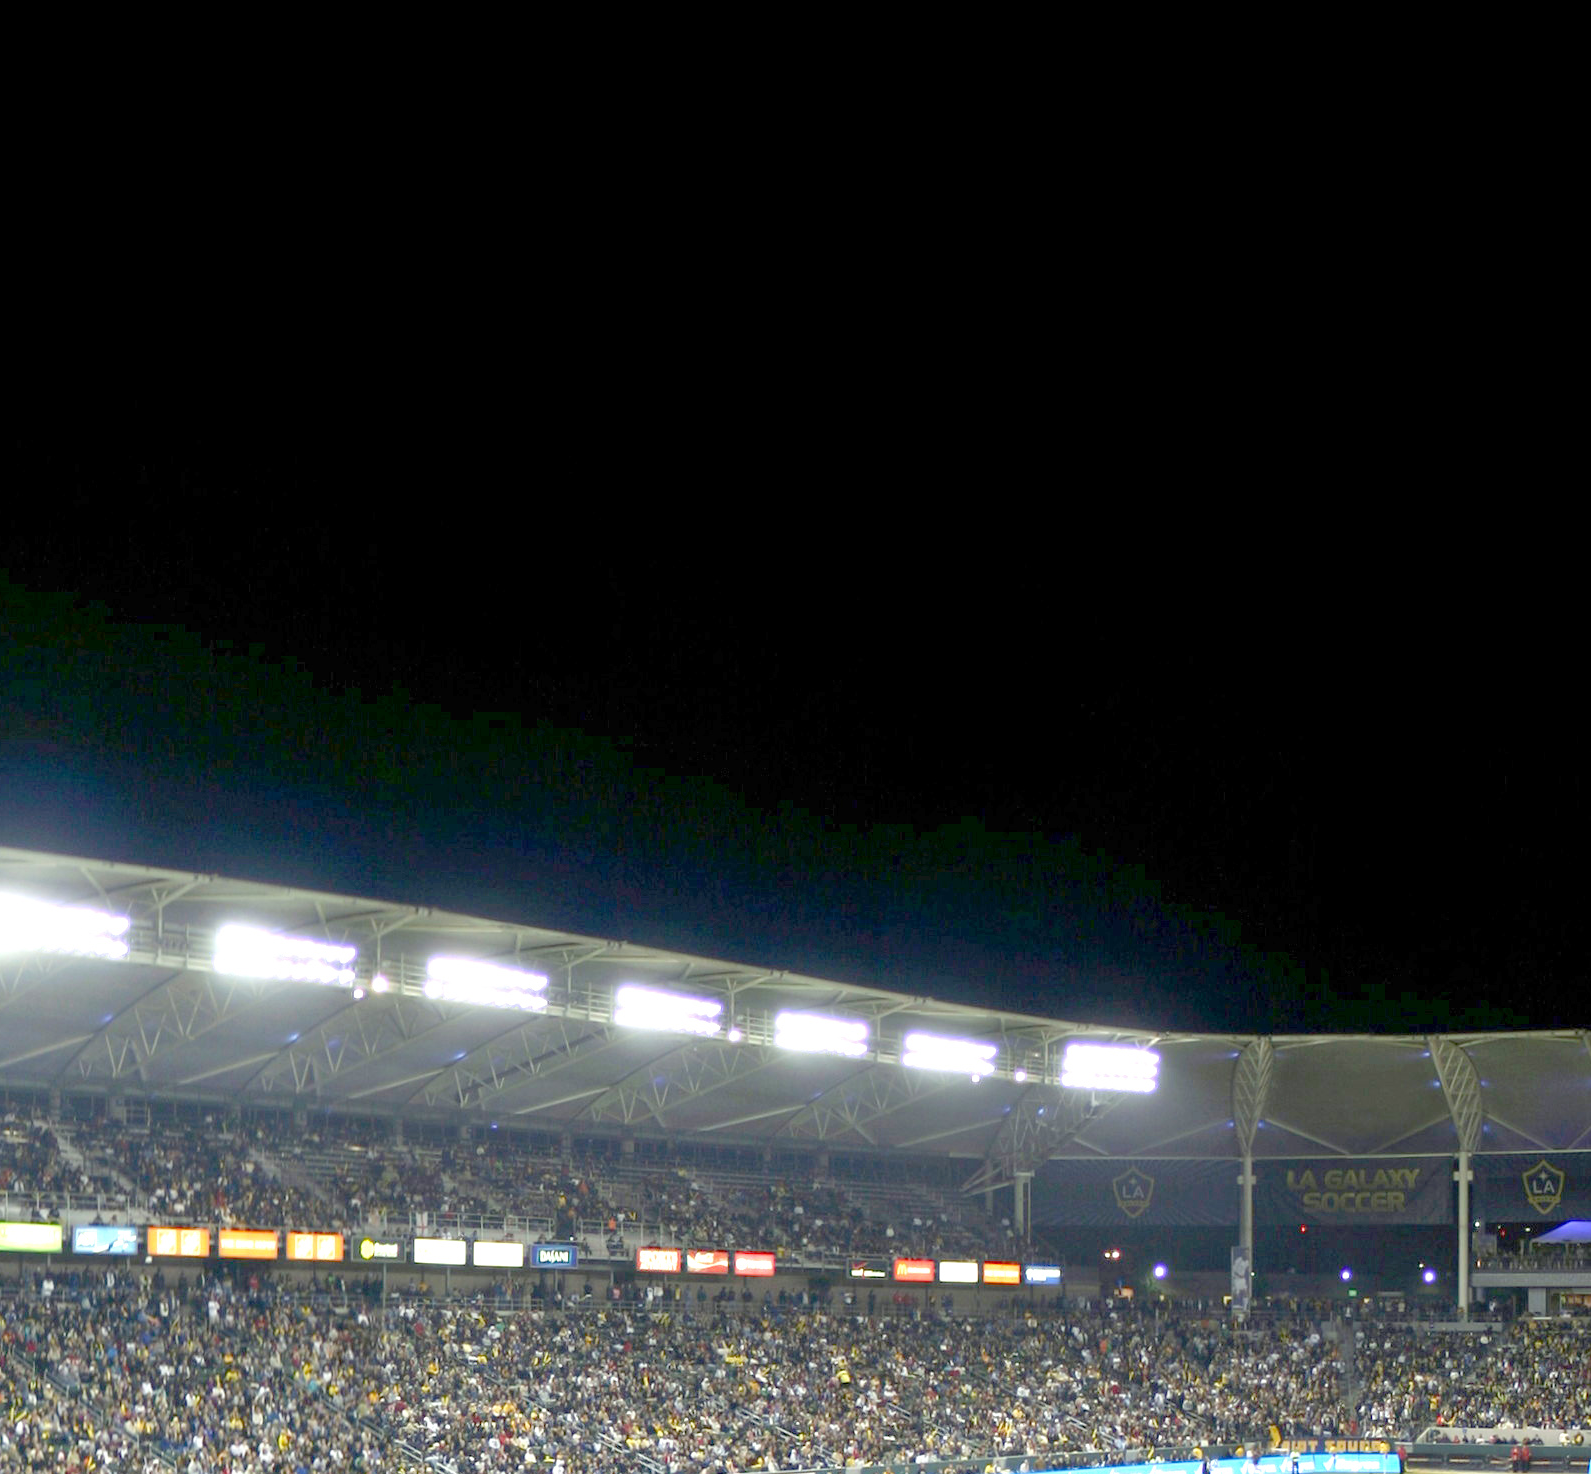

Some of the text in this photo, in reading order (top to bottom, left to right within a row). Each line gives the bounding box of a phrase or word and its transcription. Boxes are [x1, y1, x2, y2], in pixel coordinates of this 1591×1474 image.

[1286, 1168, 1421, 1190] LA GALAXY
[1532, 1179, 1555, 1194] LA
[1122, 1185, 1144, 1199] LA
[1302, 1191, 1406, 1213] SOCCER
